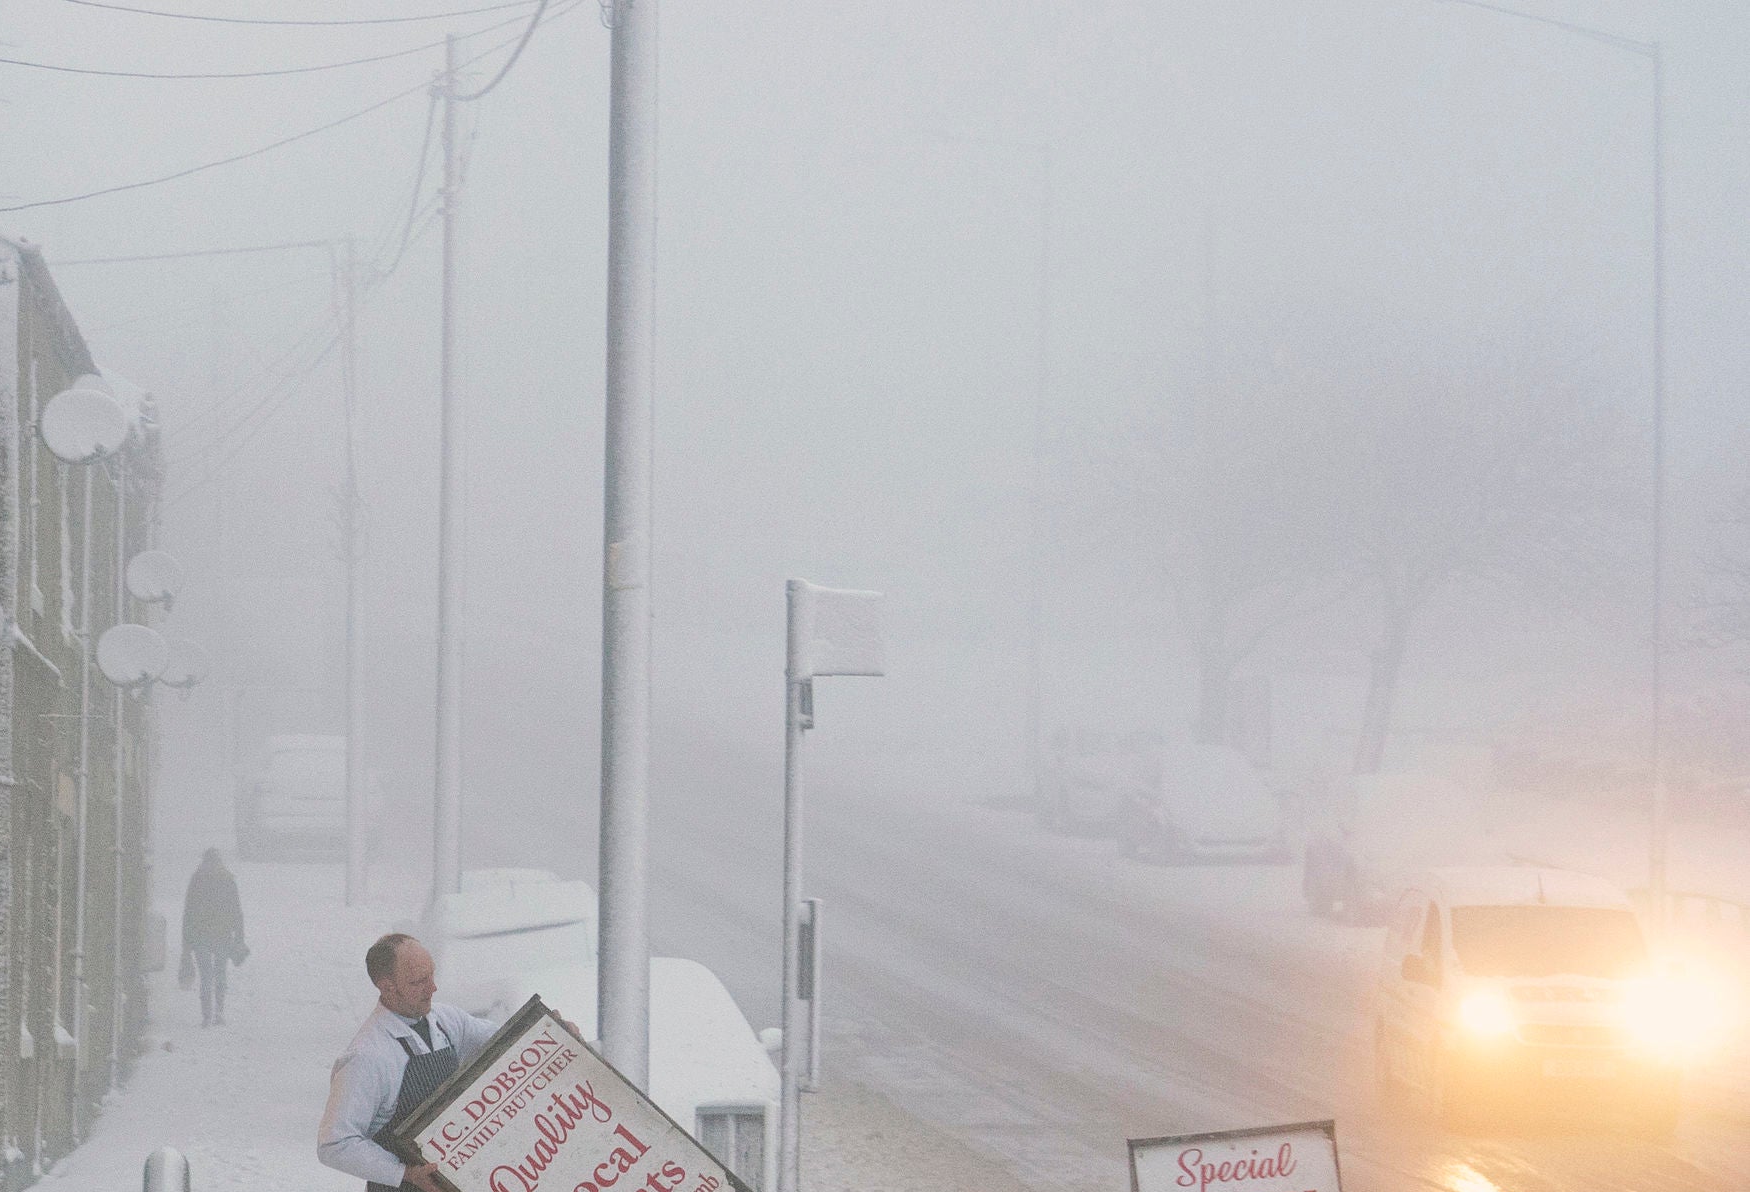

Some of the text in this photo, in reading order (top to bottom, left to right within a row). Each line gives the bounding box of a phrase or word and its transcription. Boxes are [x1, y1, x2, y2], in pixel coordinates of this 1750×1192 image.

[427, 1031, 558, 1161] J.C. DOBSON
[446, 1048, 578, 1171] FAMILY BUTCHER
